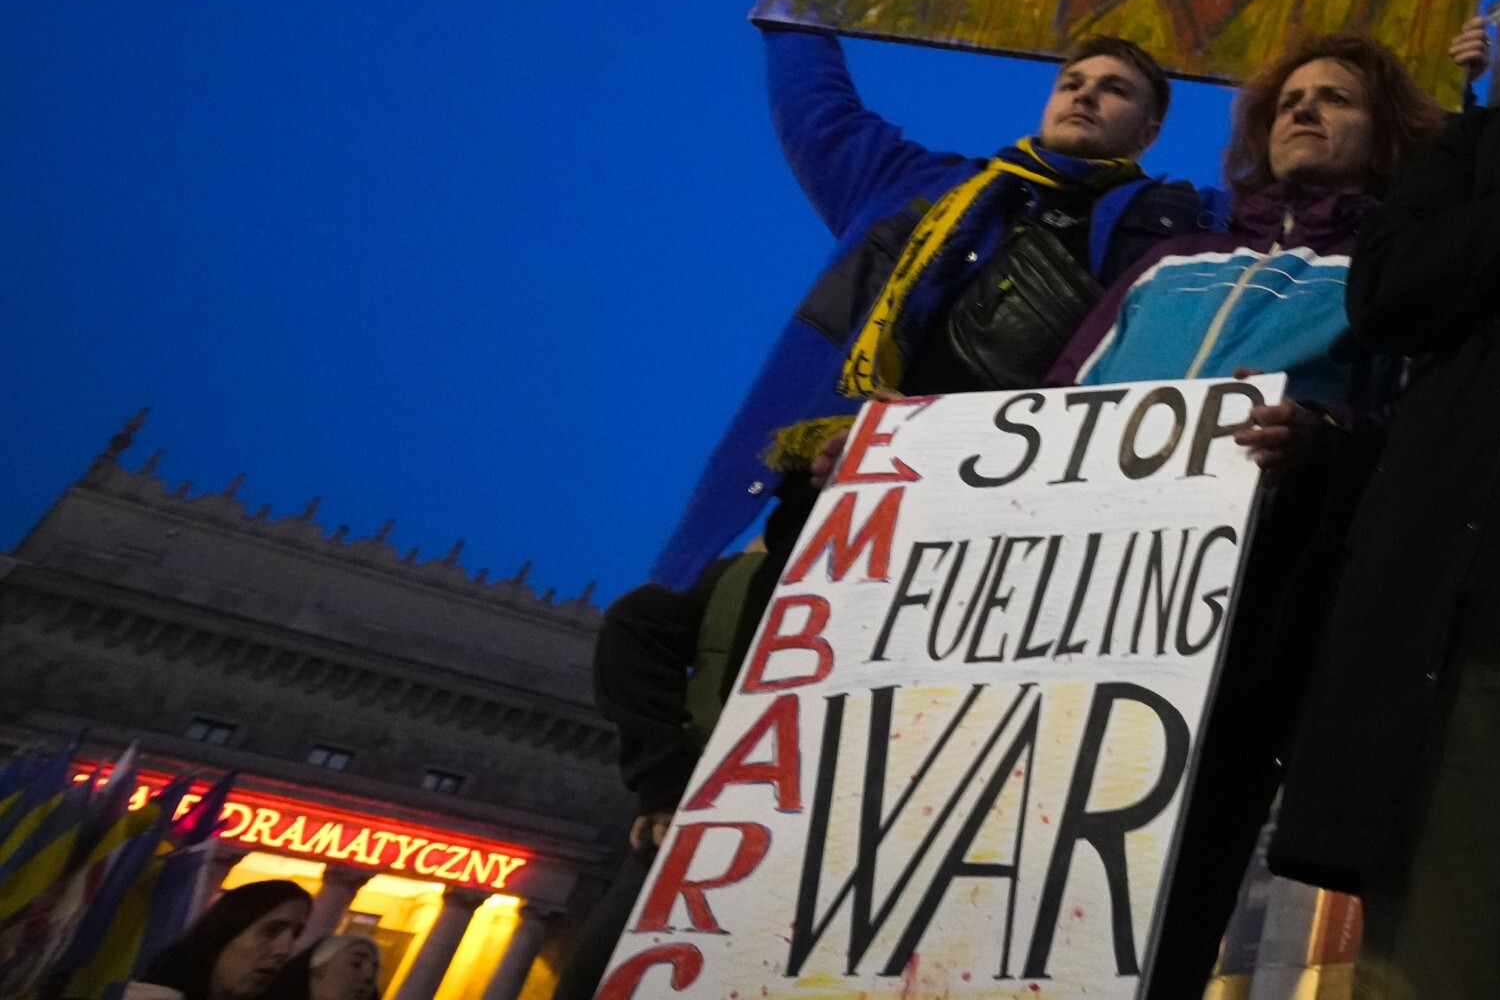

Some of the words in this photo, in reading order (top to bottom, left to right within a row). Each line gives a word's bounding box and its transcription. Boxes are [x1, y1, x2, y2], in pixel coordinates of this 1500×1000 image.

[957, 382, 1265, 488] STOP
[868, 525, 1238, 663] FUELLING
[219, 802, 526, 888] DRAMATYCZNY
[785, 681, 1191, 979] WAR
